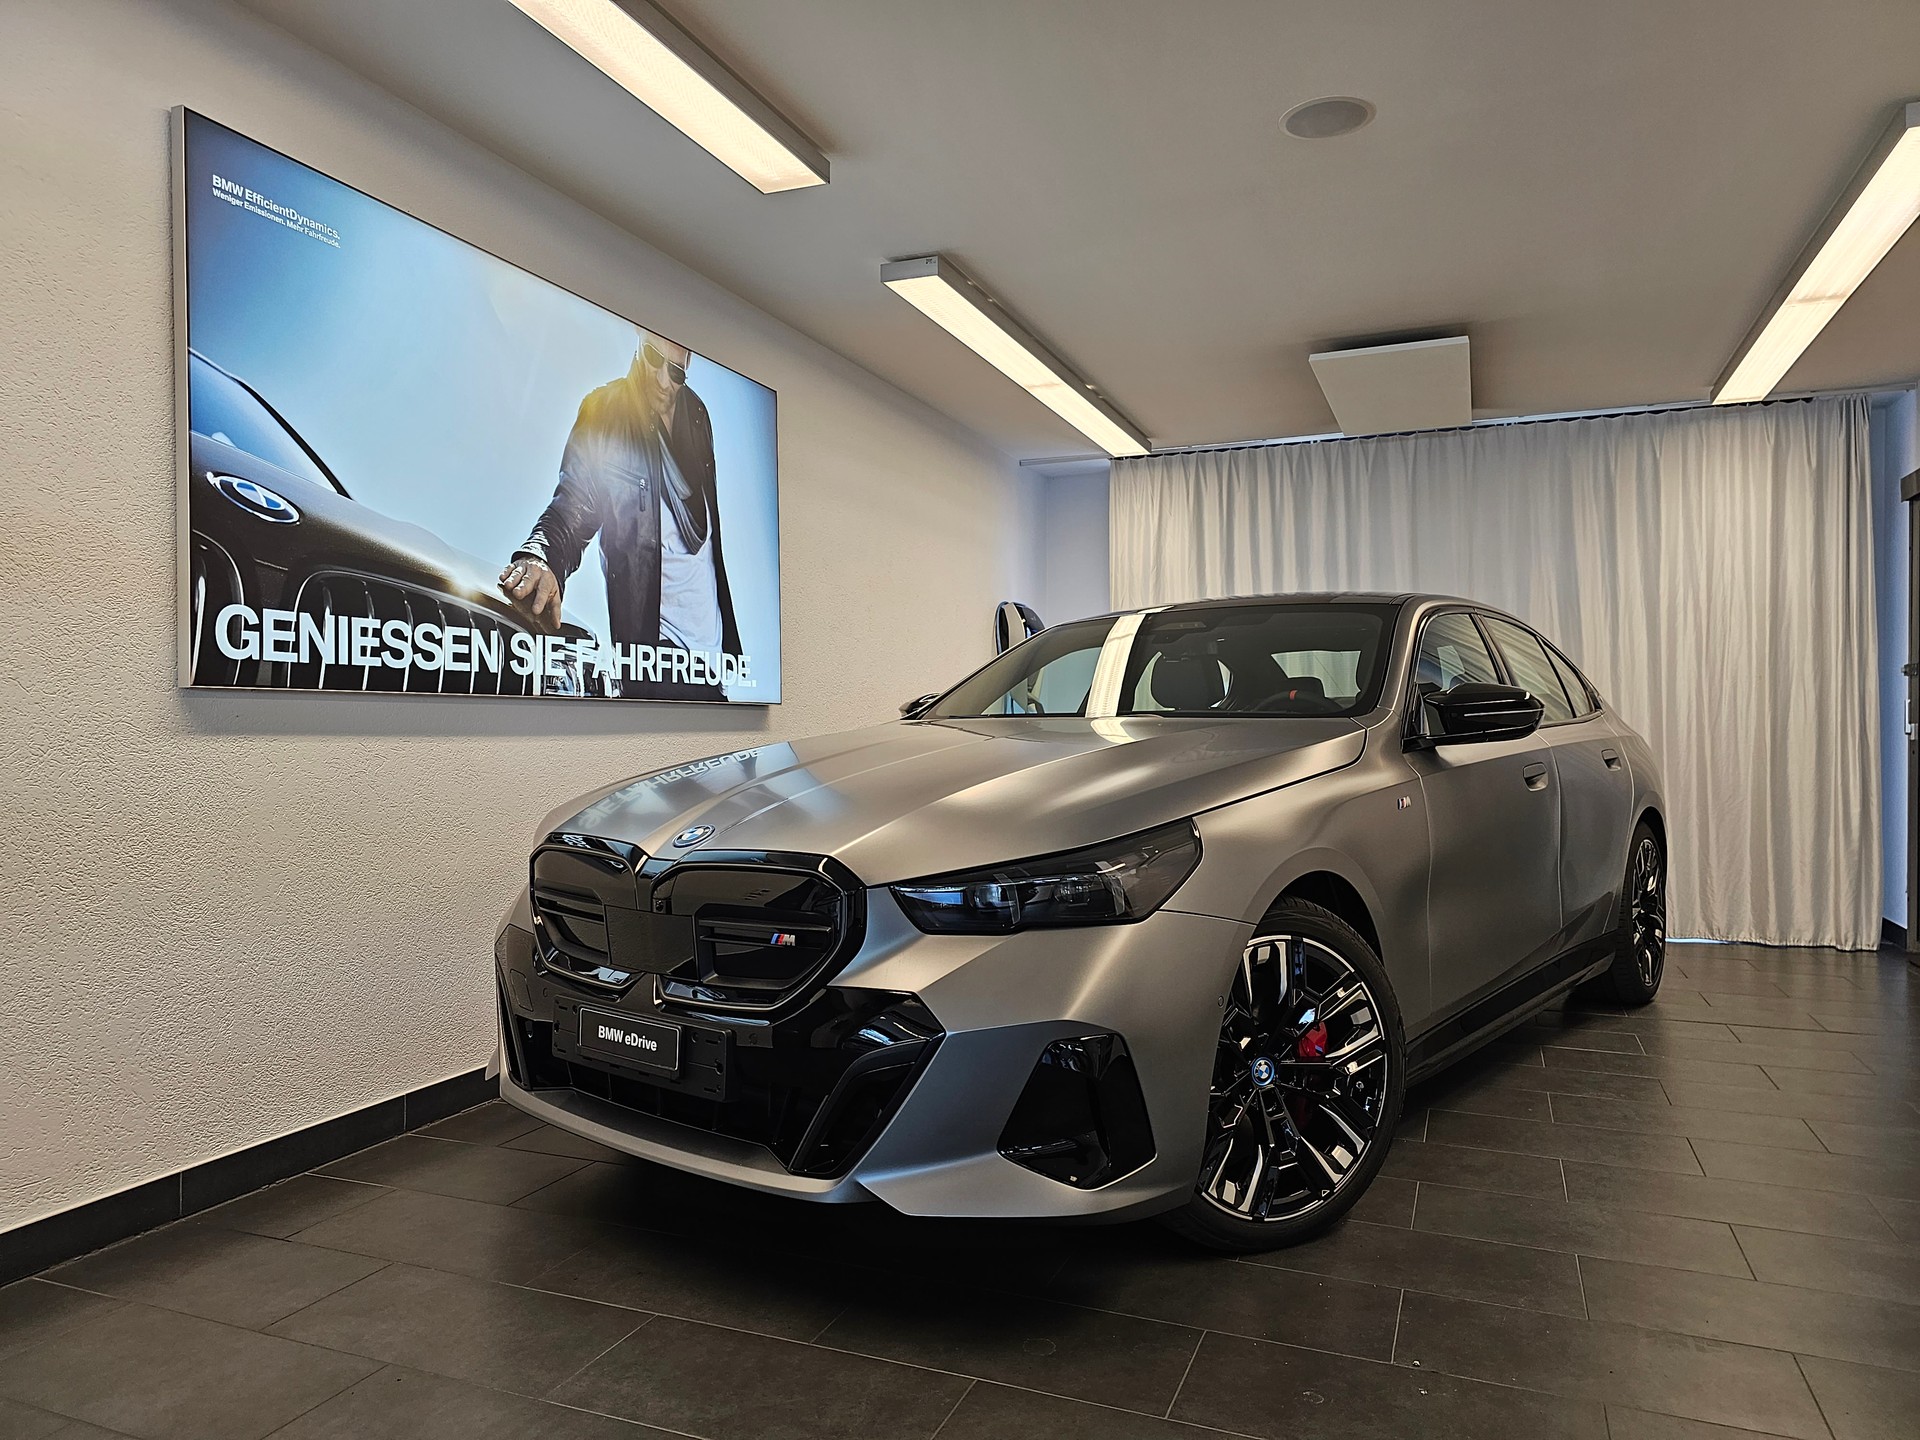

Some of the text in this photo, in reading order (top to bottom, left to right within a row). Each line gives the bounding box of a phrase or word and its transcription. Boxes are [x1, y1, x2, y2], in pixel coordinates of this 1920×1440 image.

[212, 174, 341, 240] BMW EfficientDynamics.
[212, 187, 341, 249] Weniger Emissionen. Mehr Fahrfreude.
[215, 603, 757, 688] GENIESSEN SIE FAHRFREUDE.
[598, 1025, 658, 1052] BMW eDrive
